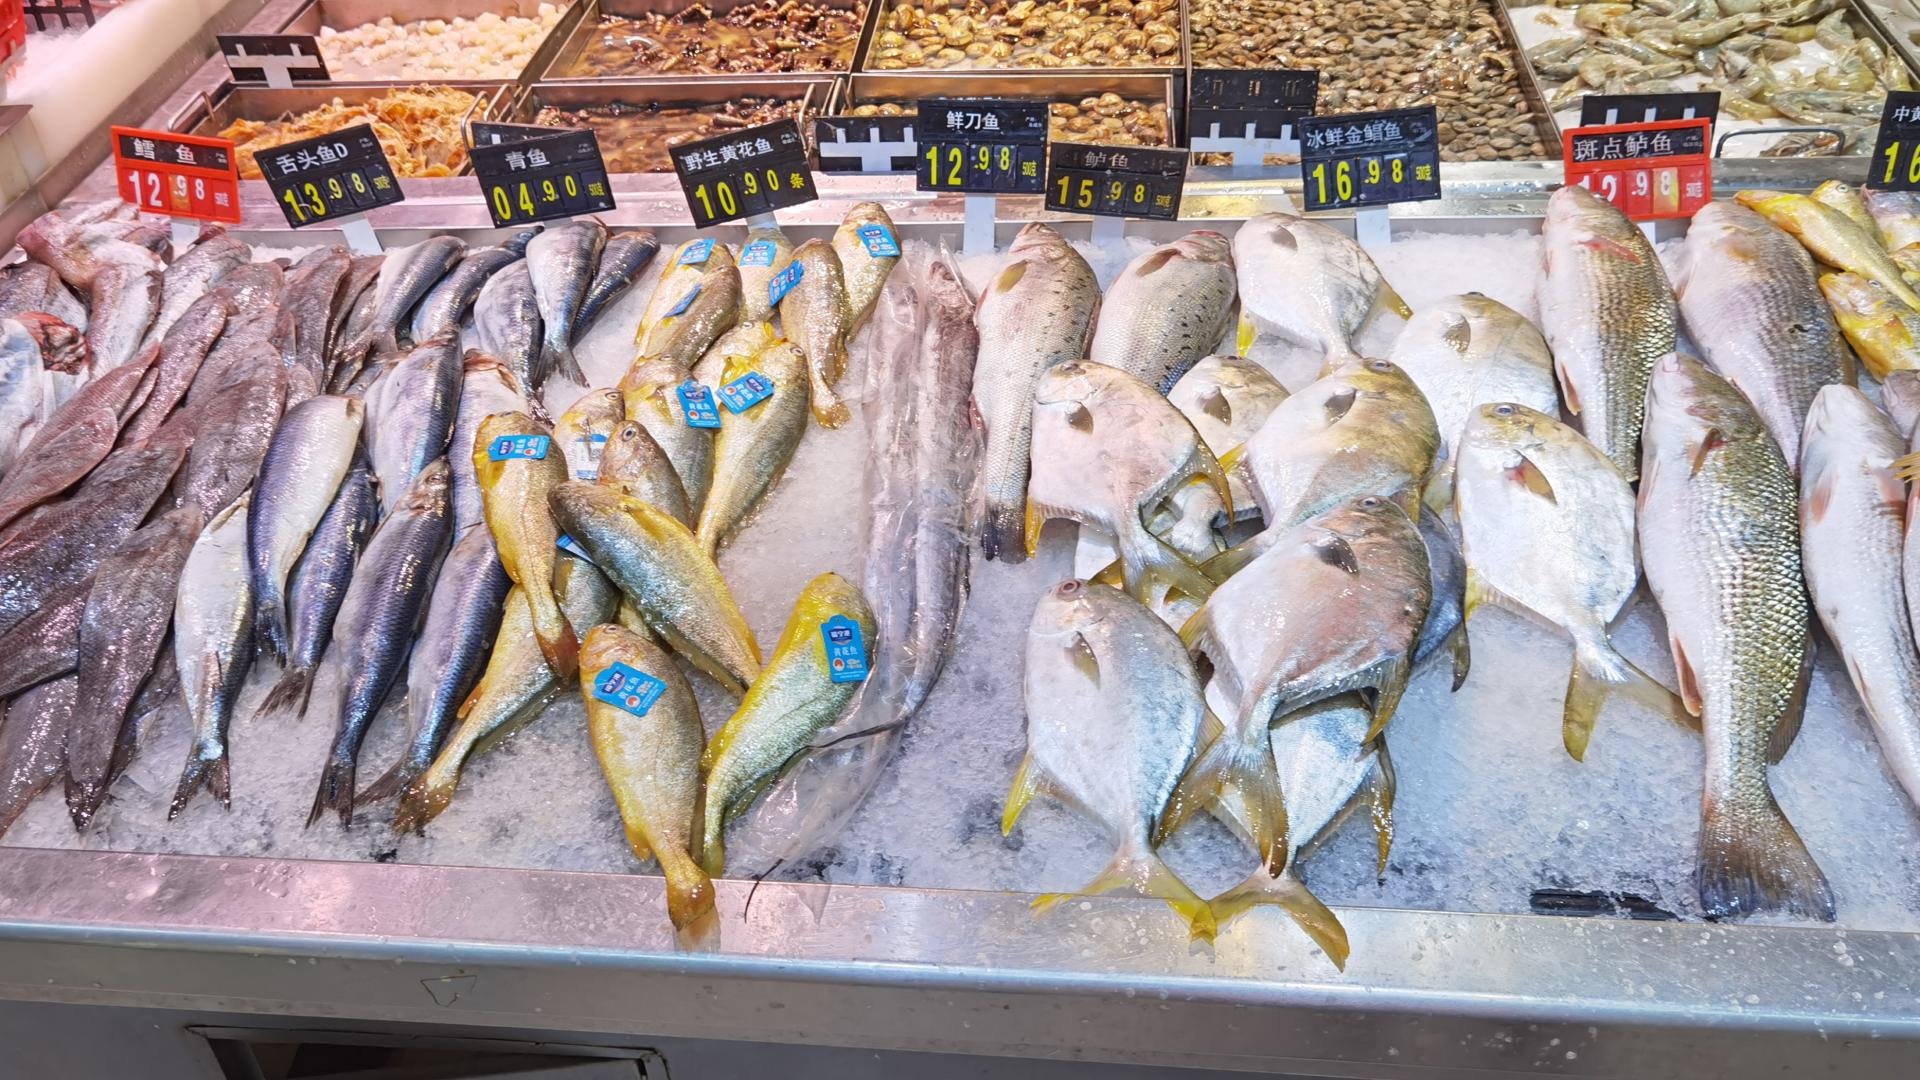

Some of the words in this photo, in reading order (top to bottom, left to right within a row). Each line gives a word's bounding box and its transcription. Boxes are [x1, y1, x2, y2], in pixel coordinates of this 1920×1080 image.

[946, 110, 1000, 131] 鲜刀鱼
[1306, 120, 1403, 149] 冰鲜金鲳鱼
[1574, 133, 1674, 161] 斑点鲈鱼
[276, 142, 349, 175] 舌头鱼D
[505, 147, 551, 171] 青鱼
[684, 137, 774, 171] 野生黄花鱼
[1084, 151, 1129, 169] 鲈鱼
[789, 172, 805, 189] 条
